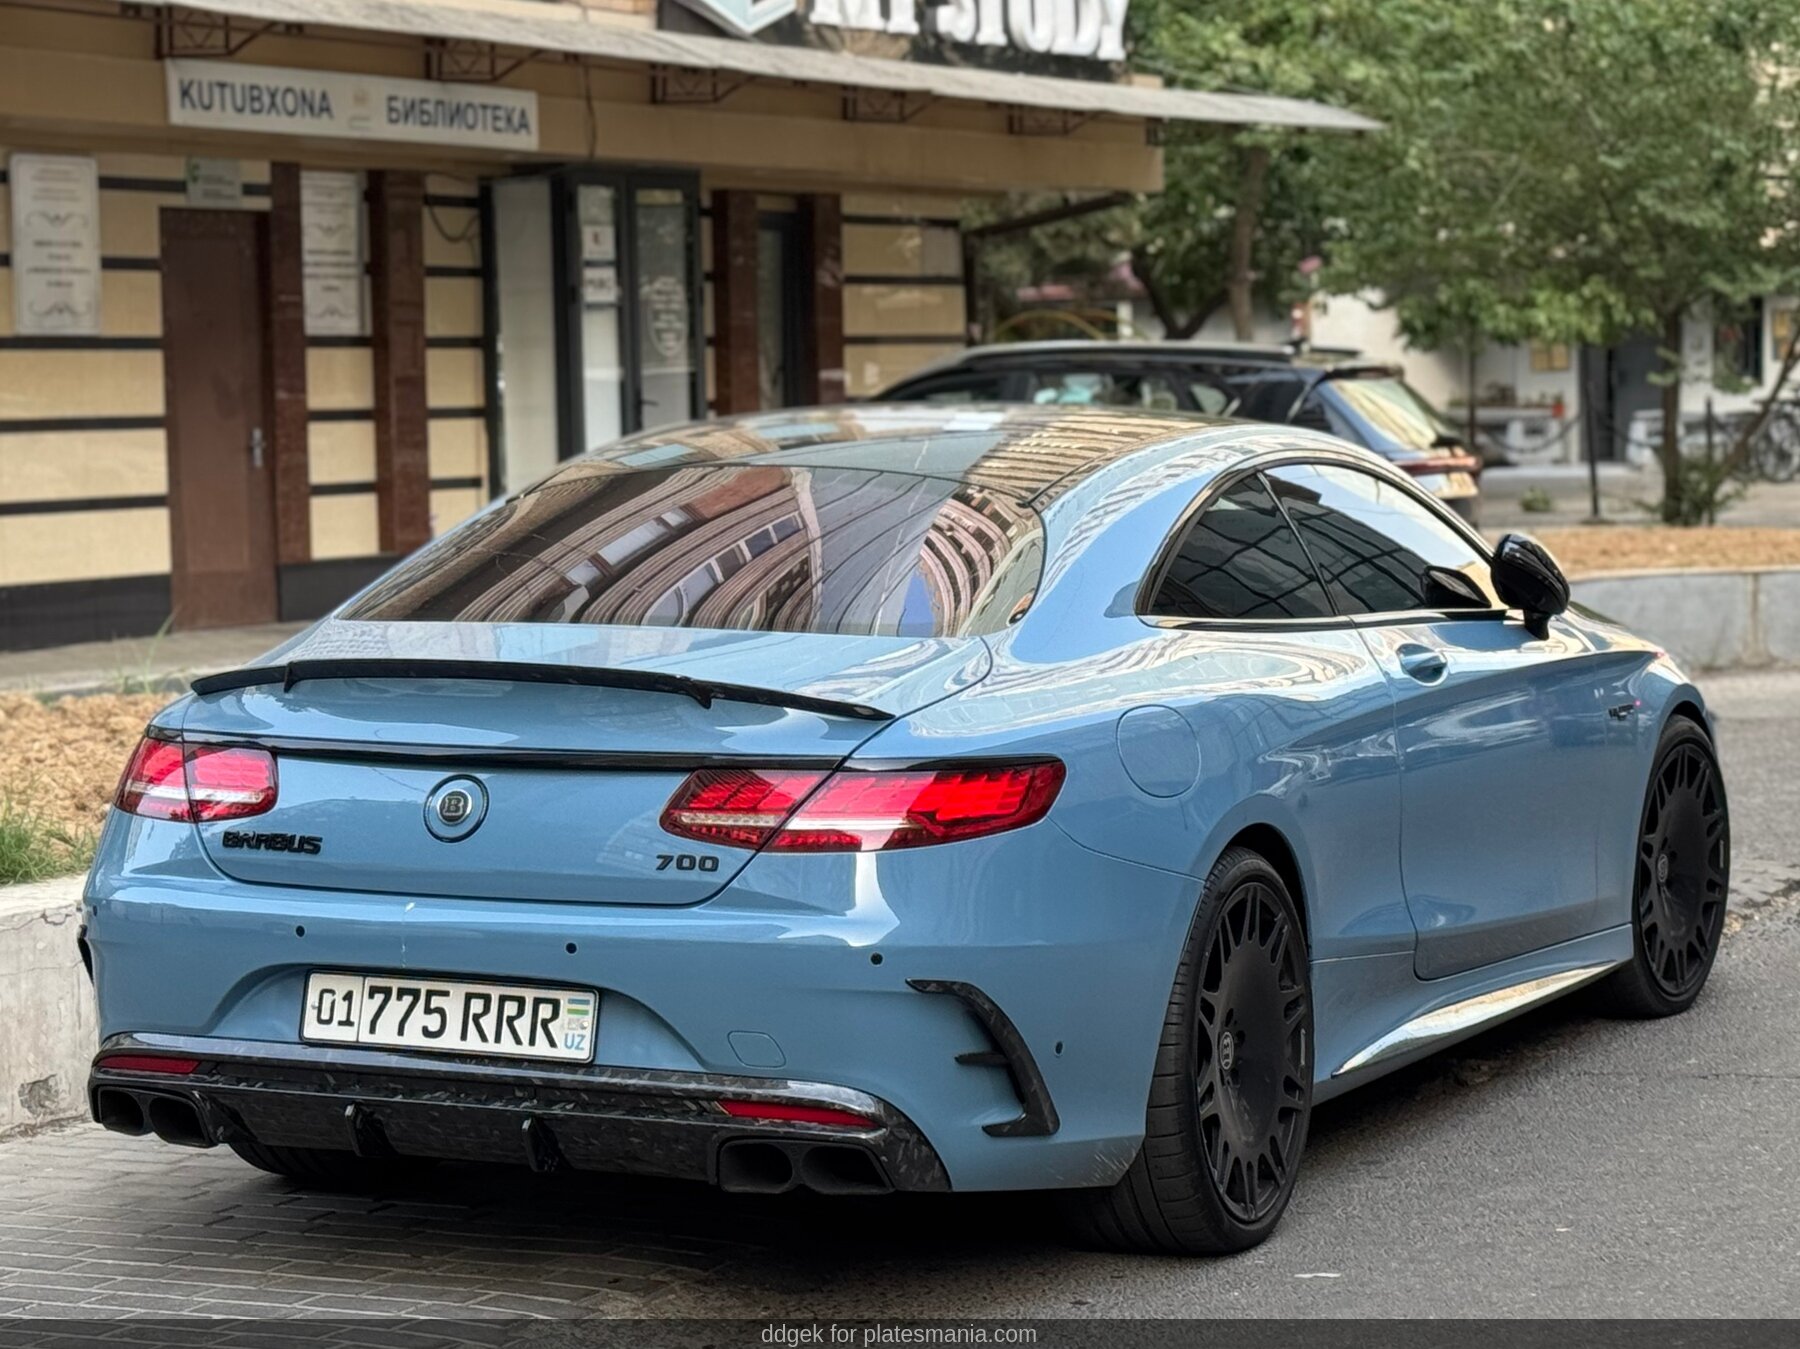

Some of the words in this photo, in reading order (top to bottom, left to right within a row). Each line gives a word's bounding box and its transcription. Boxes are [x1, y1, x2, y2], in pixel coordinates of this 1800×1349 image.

[178, 78, 334, 119] KUTUBXONA
[386, 95, 532, 135] БИБЛИОТЕКА
[223, 831, 323, 855] BRABUS
[655, 854, 720, 873] 700
[316, 988, 355, 1027] 01
[367, 985, 451, 1039] 775
[460, 991, 562, 1048] RRR
[564, 1032, 587, 1051] UZ
